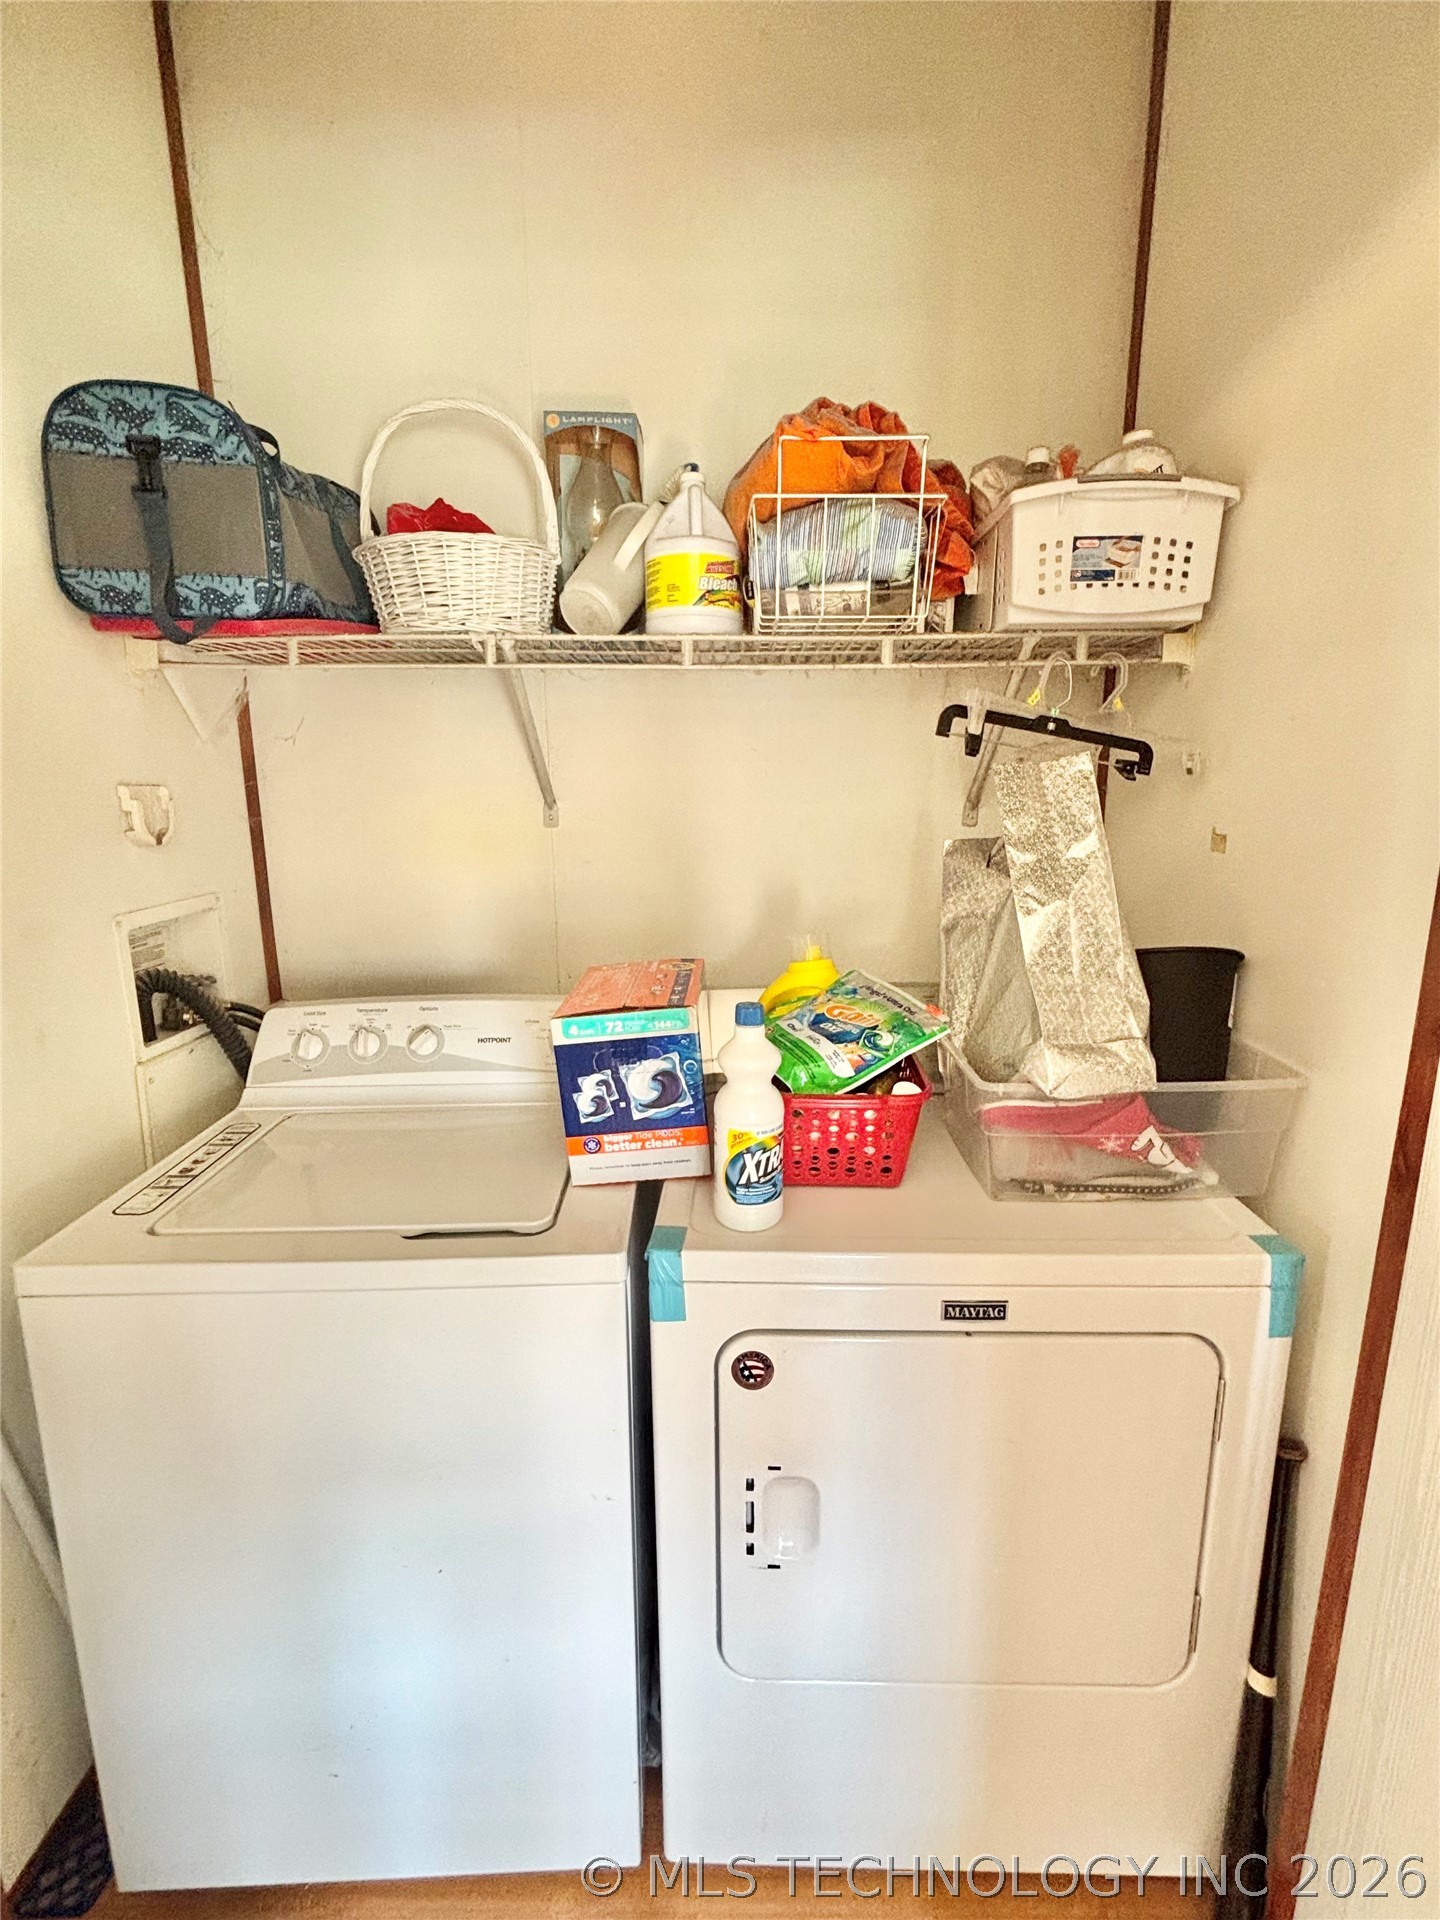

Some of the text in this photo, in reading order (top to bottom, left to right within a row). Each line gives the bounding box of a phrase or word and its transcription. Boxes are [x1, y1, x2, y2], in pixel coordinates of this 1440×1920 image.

[562, 415, 629, 425] LAMPLIGHT
[698, 576, 738, 591] Bleach
[824, 1003, 884, 1027] Gain
[568, 1024, 579, 1036] 4
[604, 1021, 624, 1034] 72
[603, 1133, 633, 1143] bigger
[635, 1131, 654, 1140] Tide
[604, 1141, 643, 1152] better
[945, 1306, 1005, 1318] MAYTAG
